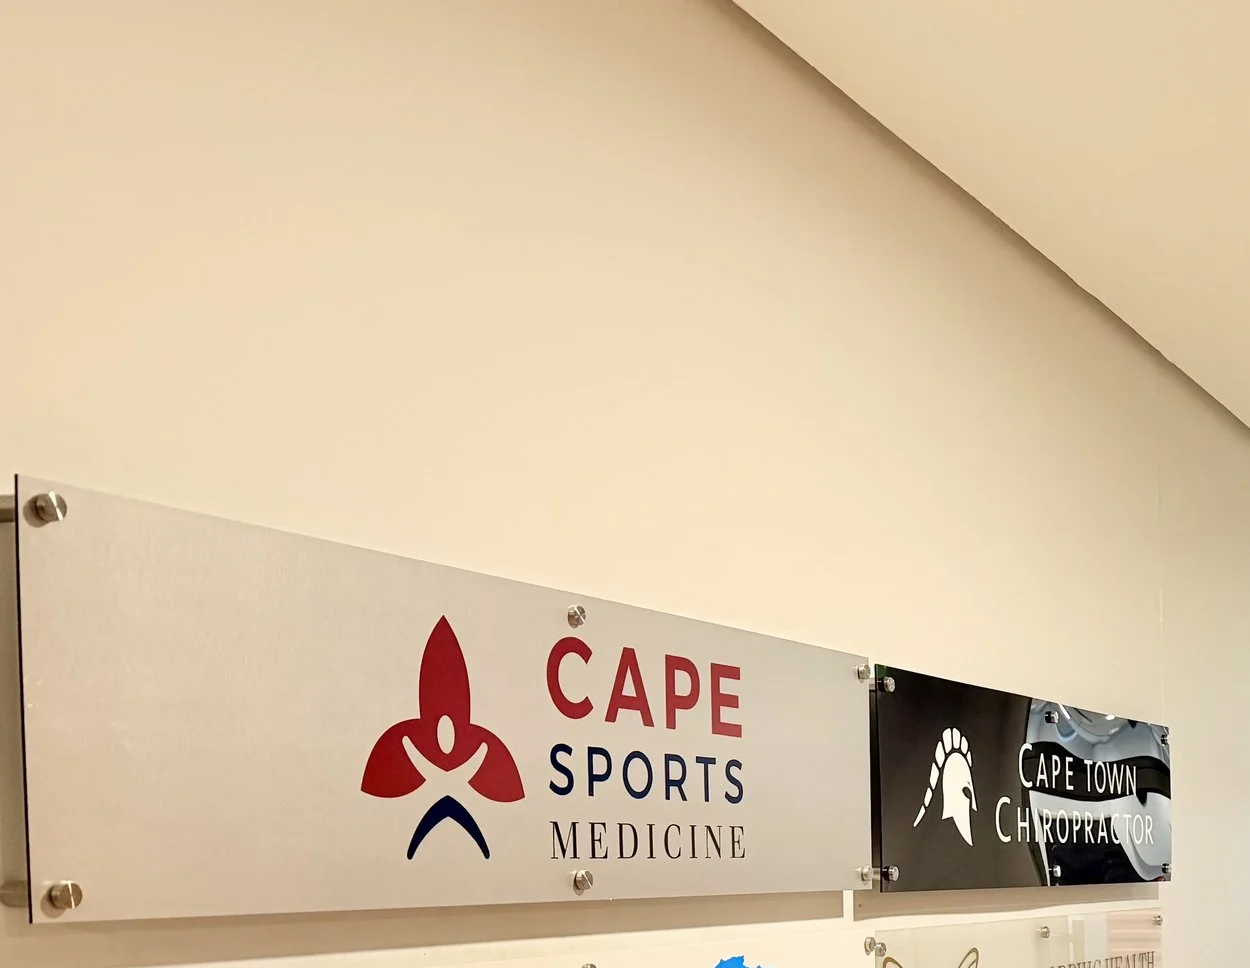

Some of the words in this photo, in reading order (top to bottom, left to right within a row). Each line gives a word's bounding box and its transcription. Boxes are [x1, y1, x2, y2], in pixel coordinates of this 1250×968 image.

[546, 636, 742, 738] CAPE
[549, 743, 744, 804] SPORTS
[1018, 742, 1074, 790] CAPE
[1083, 758, 1137, 795] TOWN
[549, 820, 746, 860] MEDICINE
[995, 796, 1154, 845] CHIROPRACTOR
